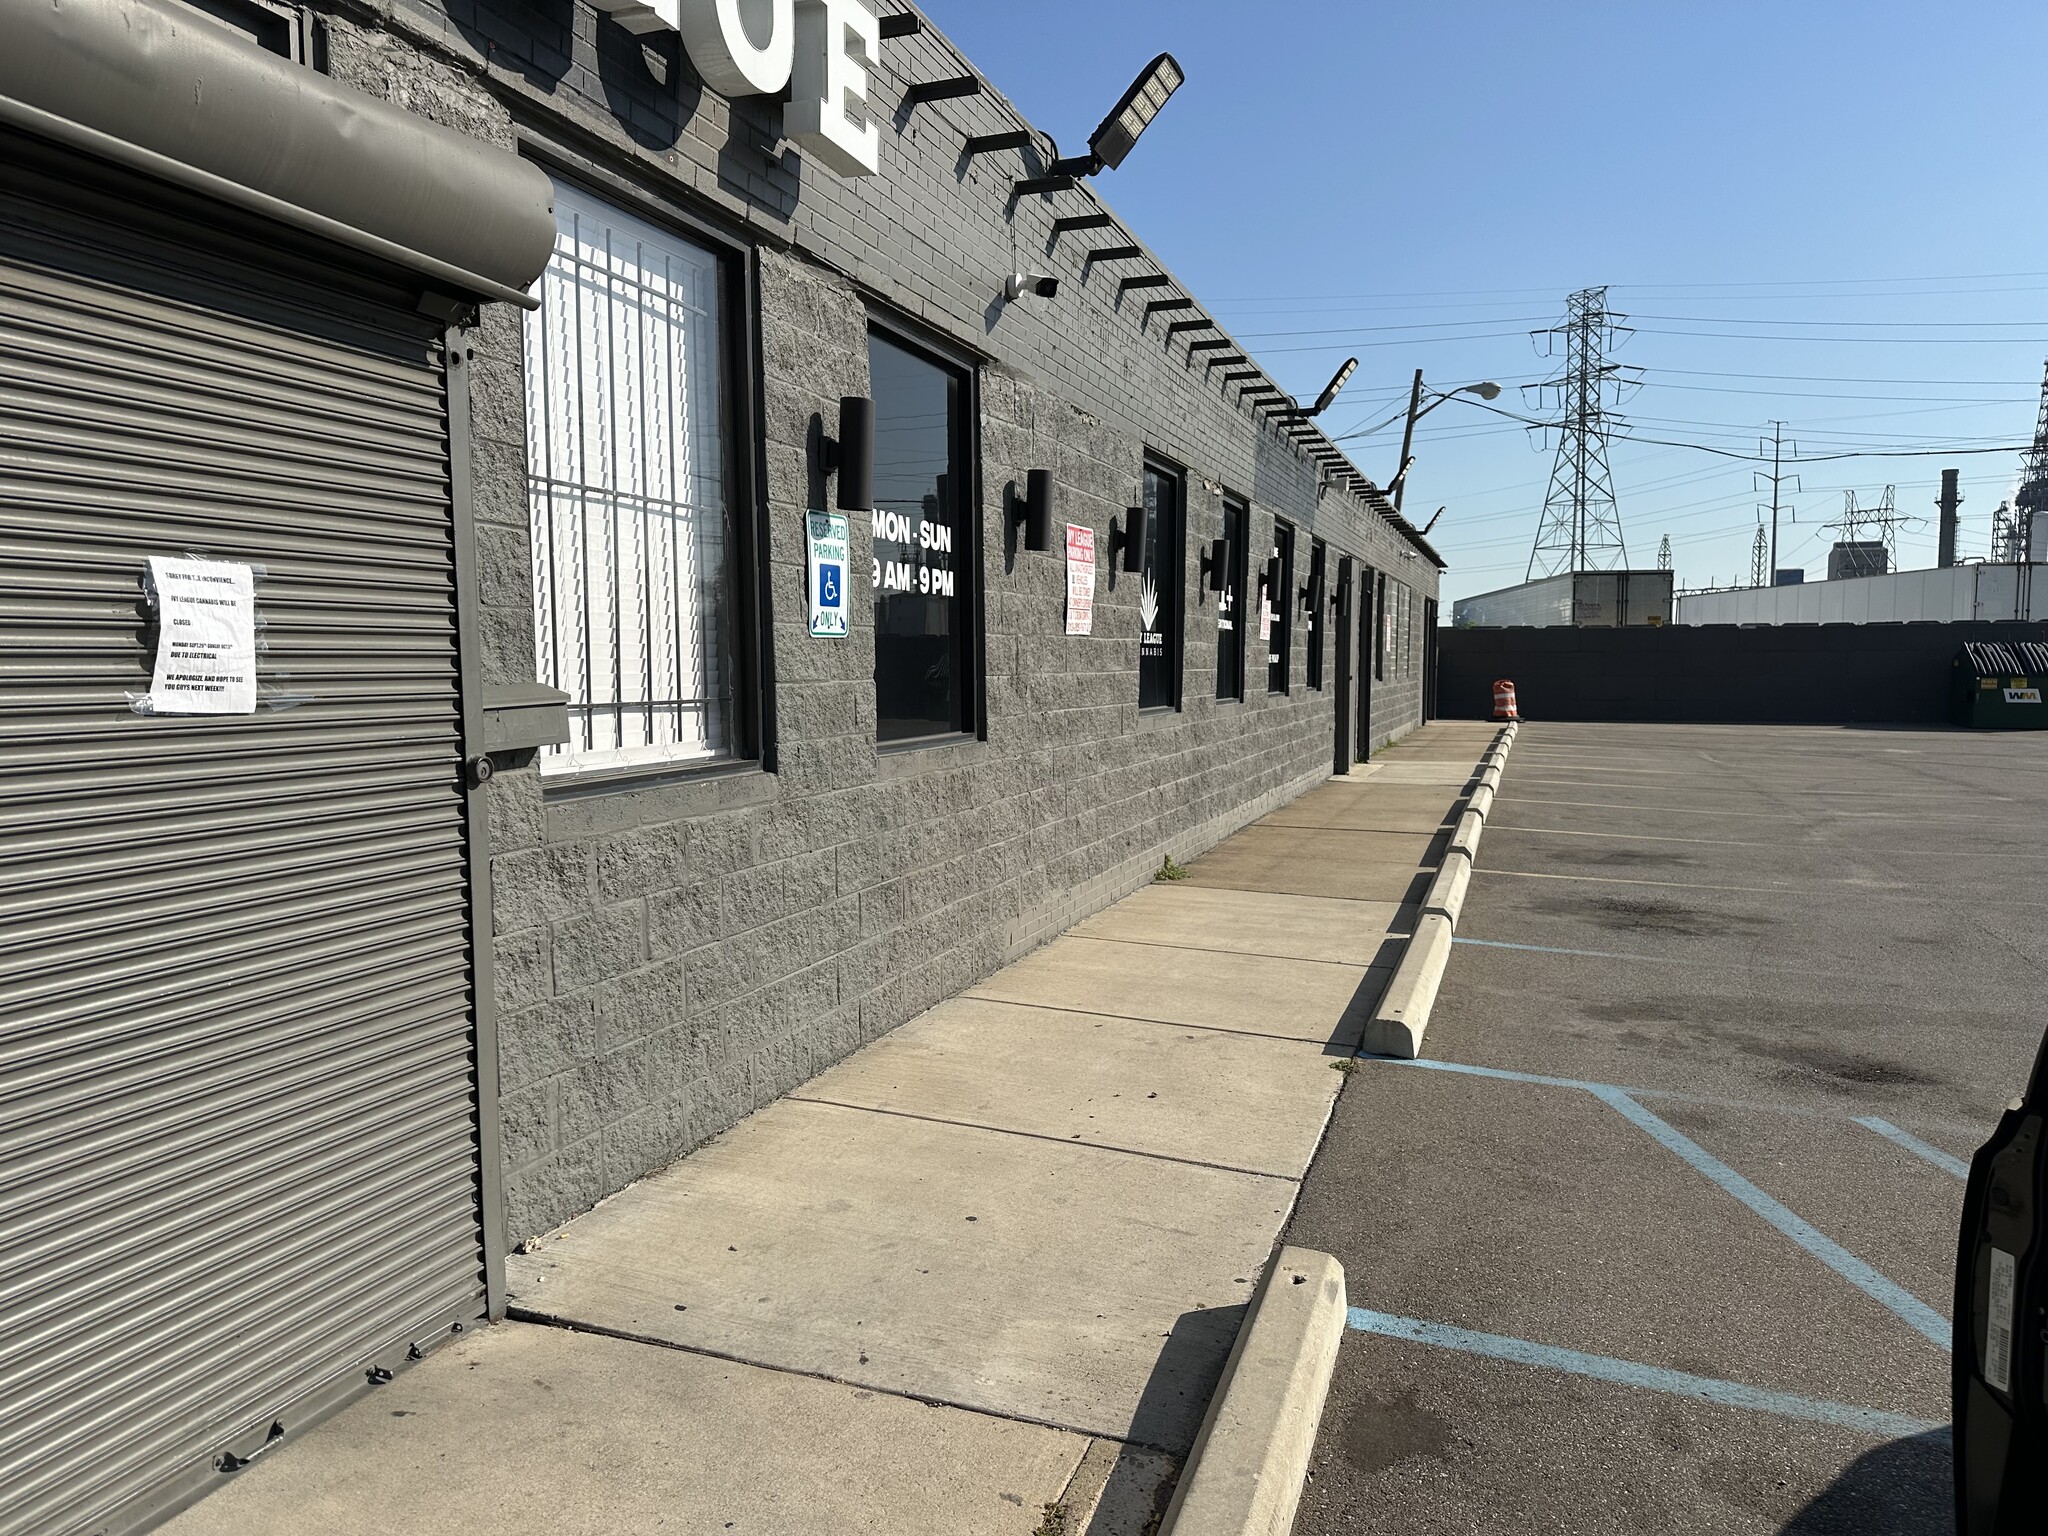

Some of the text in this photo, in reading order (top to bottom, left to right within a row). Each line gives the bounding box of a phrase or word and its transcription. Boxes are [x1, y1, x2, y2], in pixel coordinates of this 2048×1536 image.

[810, 520, 846, 541] RESERVED
[872, 508, 911, 545] MON
[920, 519, 952, 553] SUN
[813, 542, 845, 561] PARKING
[872, 557, 881, 588] 9
[884, 560, 911, 592] AM
[920, 566, 930, 594] 9
[932, 568, 954, 597] PM
[179, 596, 195, 604] LEAGUE
[196, 597, 219, 605] CANNABIS
[219, 599, 230, 607] WILL
[173, 618, 191, 626] CLOSED
[820, 610, 839, 627] ONLY
[1144, 632, 1163, 645] LEAGUE
[189, 652, 217, 660] ELECTRICAL
[1141, 647, 1163, 657] NNABIS
[175, 674, 203, 682] APOLOGIZE
[2008, 692, 2037, 700] WM
